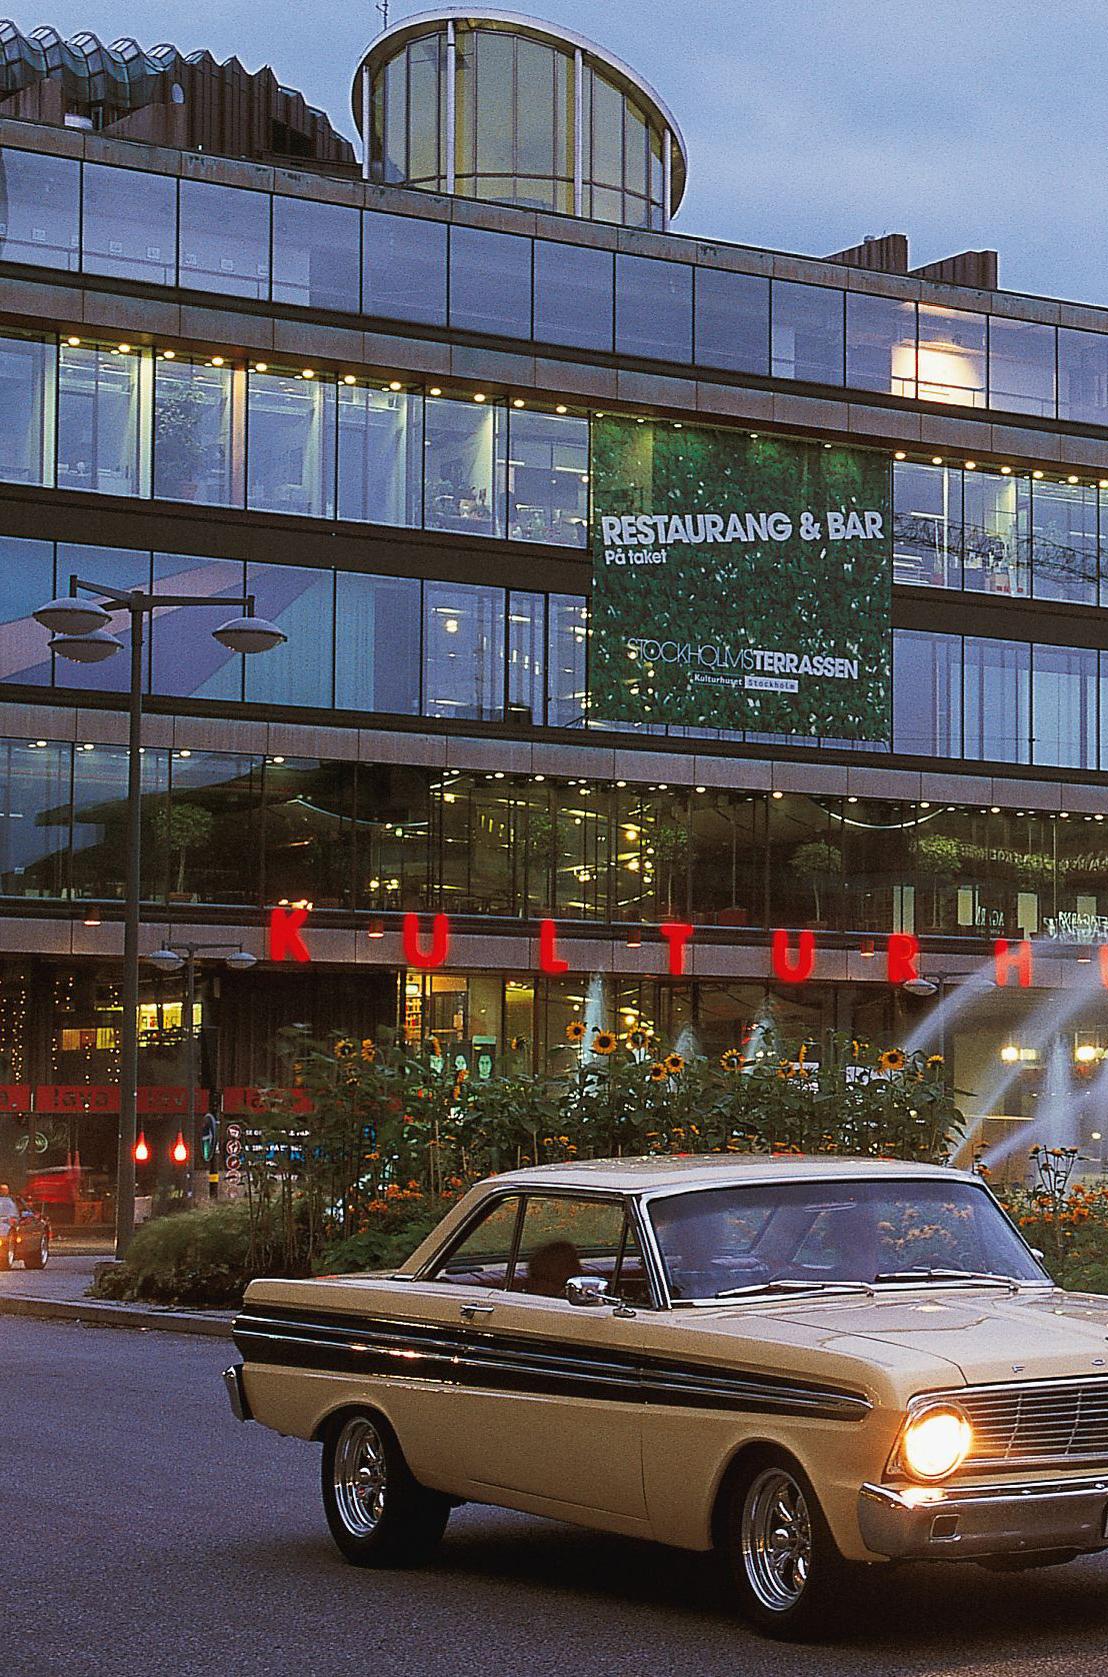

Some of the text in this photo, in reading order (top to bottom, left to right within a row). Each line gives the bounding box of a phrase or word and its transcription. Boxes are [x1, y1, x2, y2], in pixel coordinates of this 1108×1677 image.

[602, 510, 884, 545] RESTAURANG & BAR
[605, 548, 667, 565] På taket
[694, 673, 796, 691] Kulturhuset Stockholm
